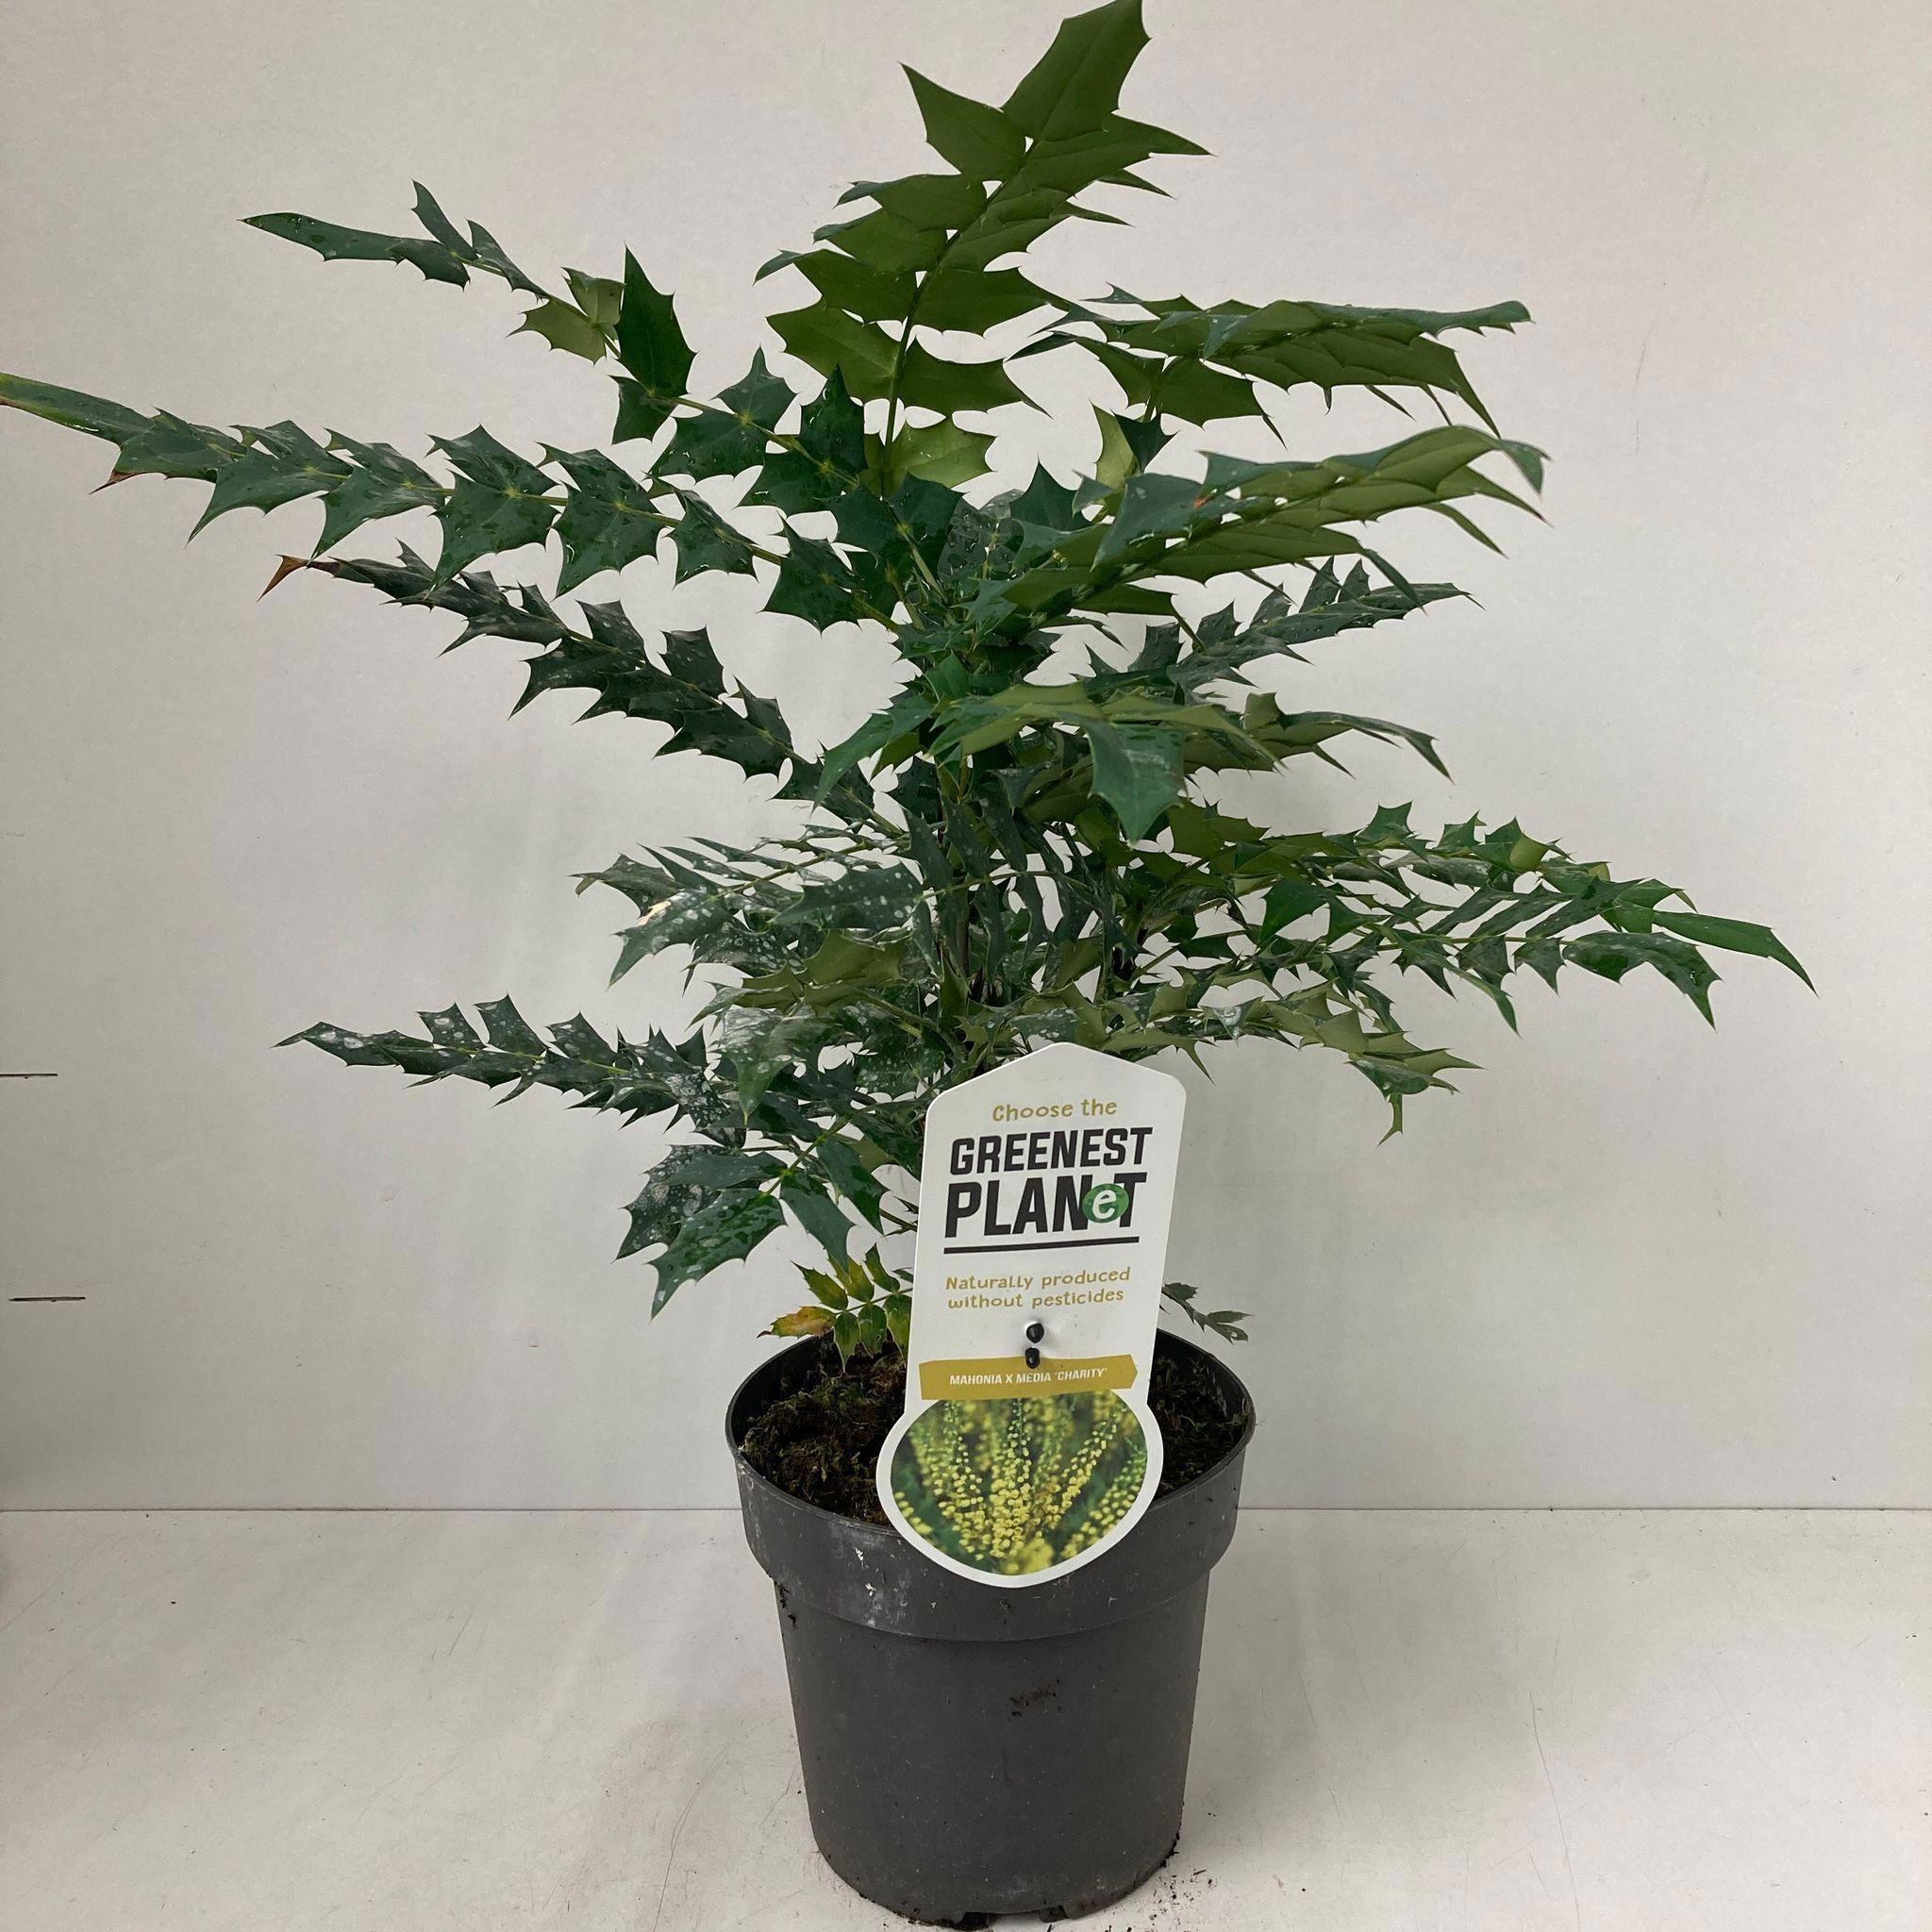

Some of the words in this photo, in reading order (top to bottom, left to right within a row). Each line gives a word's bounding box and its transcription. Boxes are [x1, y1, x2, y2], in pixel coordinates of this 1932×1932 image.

[991, 1102, 1074, 1122] Choose
[1081, 1098, 1118, 1117] the
[949, 1126, 1153, 1175] GREENEST
[945, 1274, 1034, 1291] Naturally
[1041, 1267, 1131, 1294] produced
[947, 1294, 1023, 1309] without
[1032, 1288, 1124, 1309] pesticides
[949, 1374, 1003, 1386] MAHONIA
[1005, 1374, 1014, 1384] X
[1015, 1372, 1052, 1384] MEDIA
